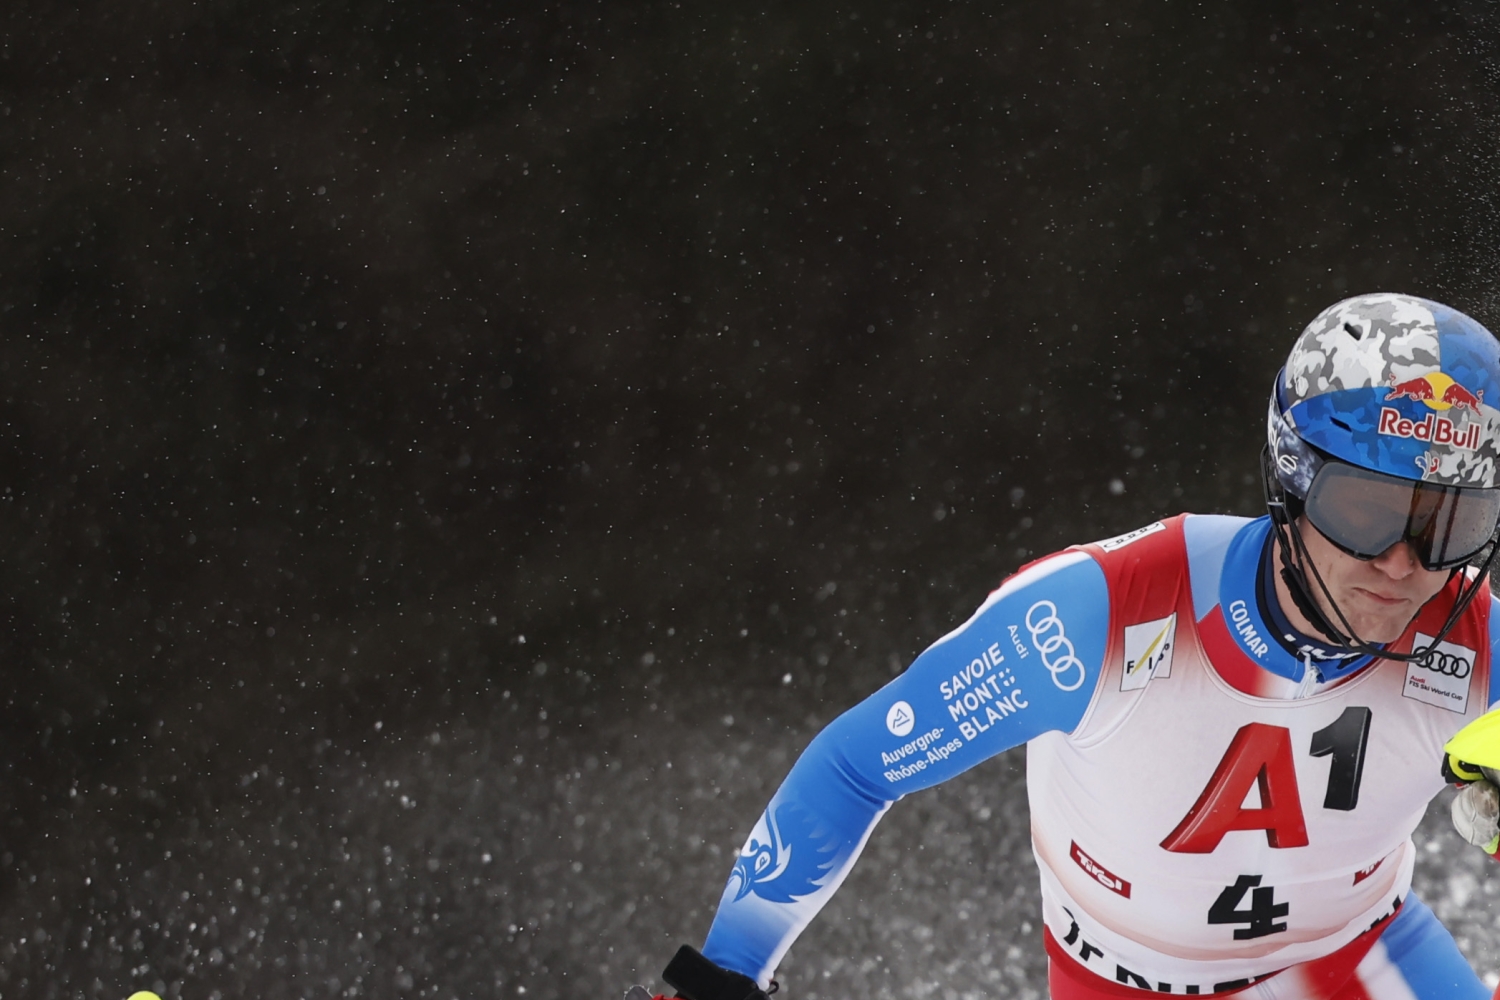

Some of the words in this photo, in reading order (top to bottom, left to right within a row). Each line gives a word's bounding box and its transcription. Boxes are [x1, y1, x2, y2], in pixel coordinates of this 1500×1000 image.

[1379, 408, 1434, 441] Red
[1432, 417, 1480, 451] Bull
[1007, 624, 1029, 659] Audi
[1229, 600, 1268, 658] COLMAR
[940, 642, 1005, 701] SAVOIE
[1409, 680, 1420, 688] FIS
[1431, 687, 1450, 697] World
[1451, 693, 1463, 702] Cup
[1410, 675, 1426, 684] Audi
[947, 674, 1003, 722] MONT
[958, 689, 1029, 742] BLANC
[881, 726, 945, 766] Auvergne-
[883, 738, 963, 783] Rhône-Alpes
[1076, 849, 1123, 891] Tirol
[1207, 874, 1289, 940] 4
